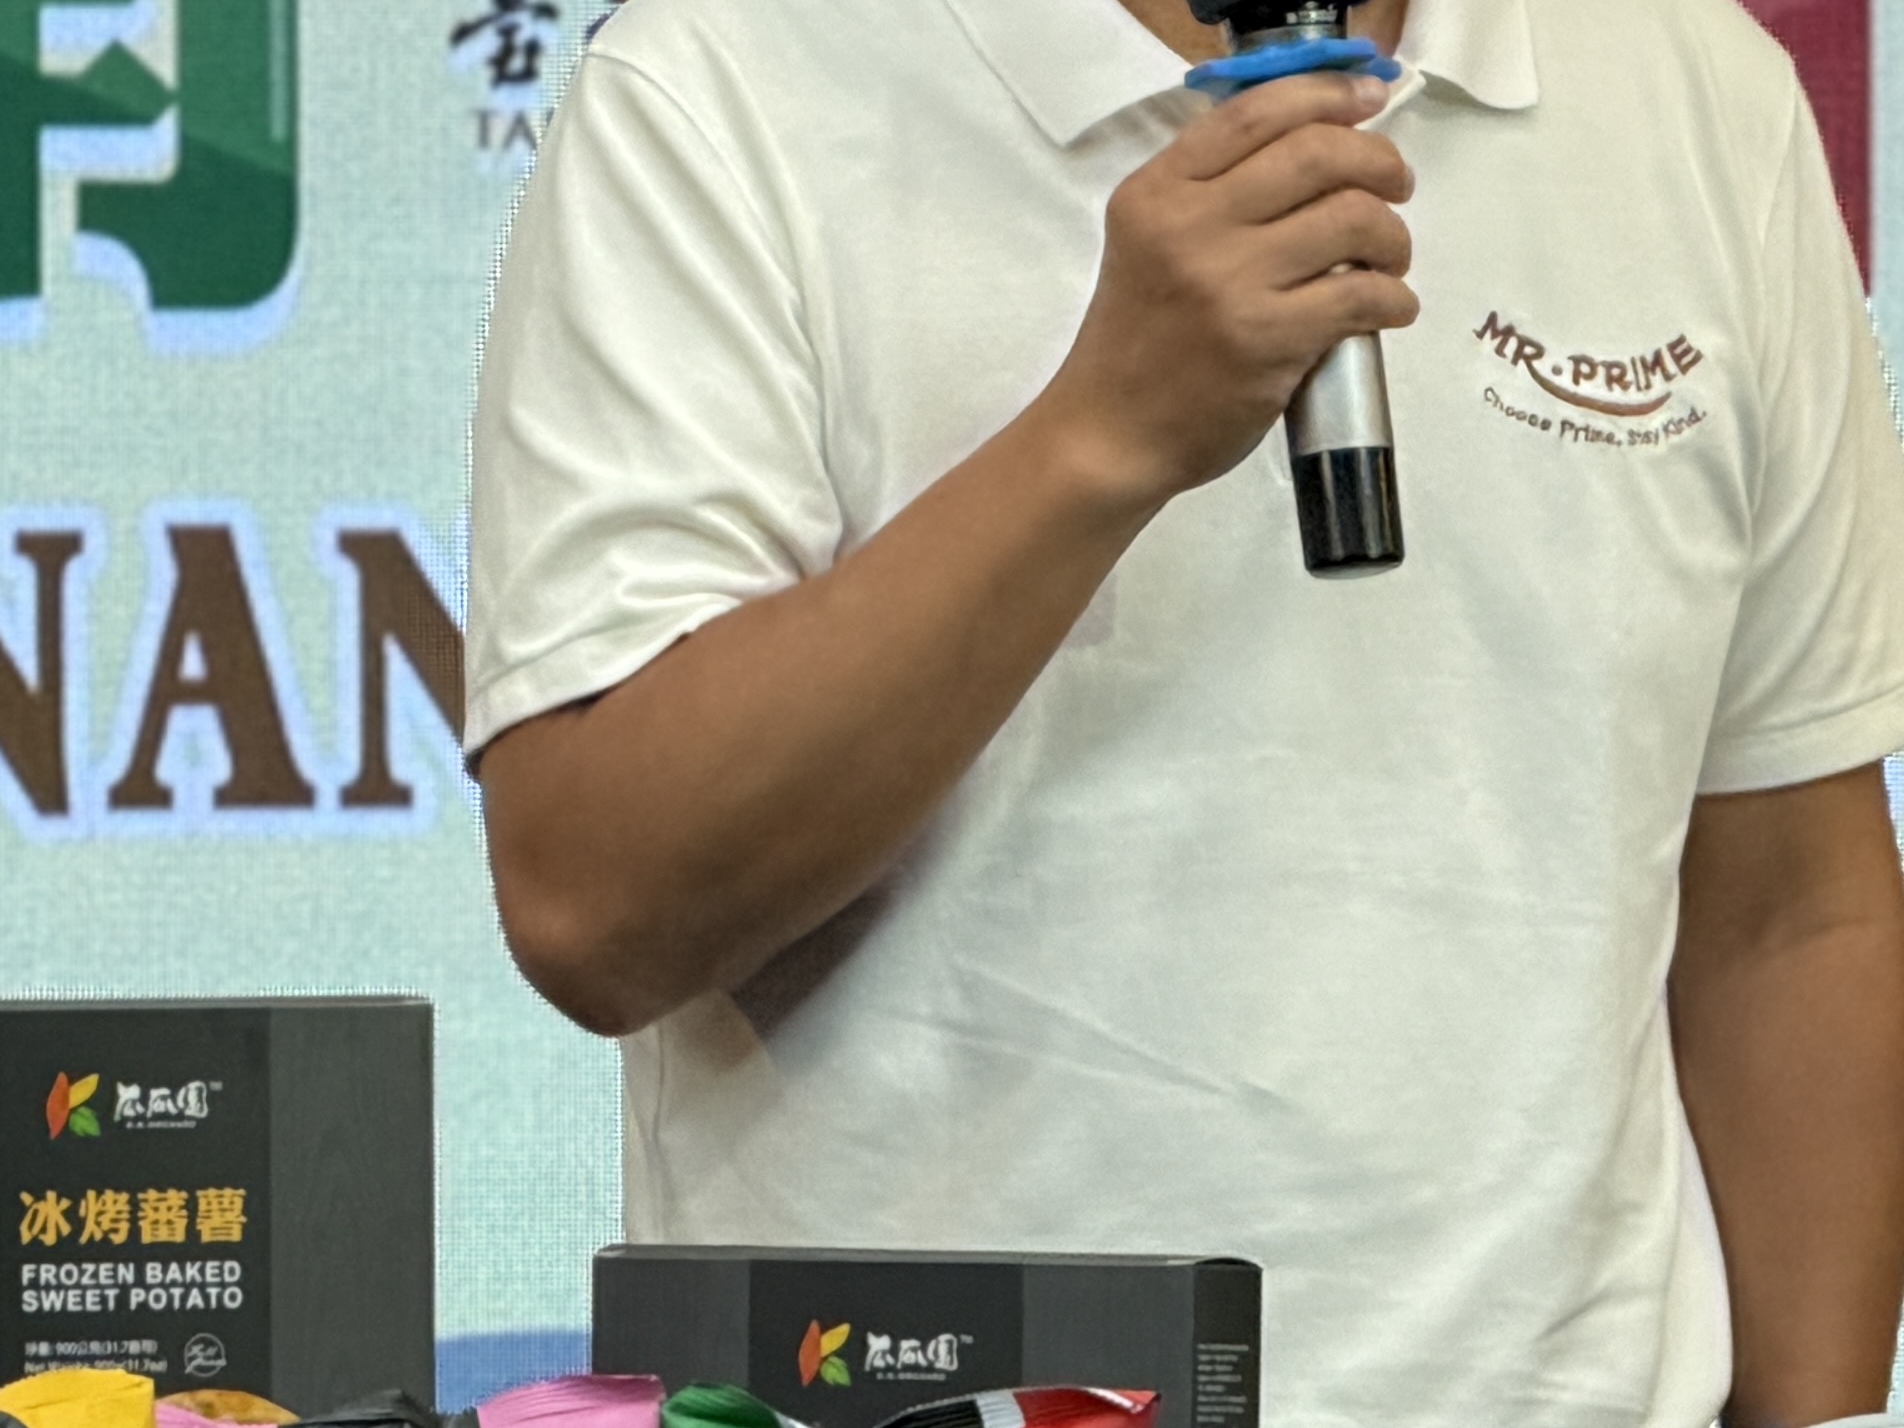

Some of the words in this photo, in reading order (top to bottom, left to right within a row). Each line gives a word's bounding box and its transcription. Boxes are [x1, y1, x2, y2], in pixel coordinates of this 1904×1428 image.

[18, 1187, 248, 1247] 冰烤蕃薯
[21, 1262, 135, 1287] FROZEN
[145, 1260, 242, 1285] BAKED
[21, 1289, 118, 1313] SWEET
[129, 1286, 243, 1310] POTATO
